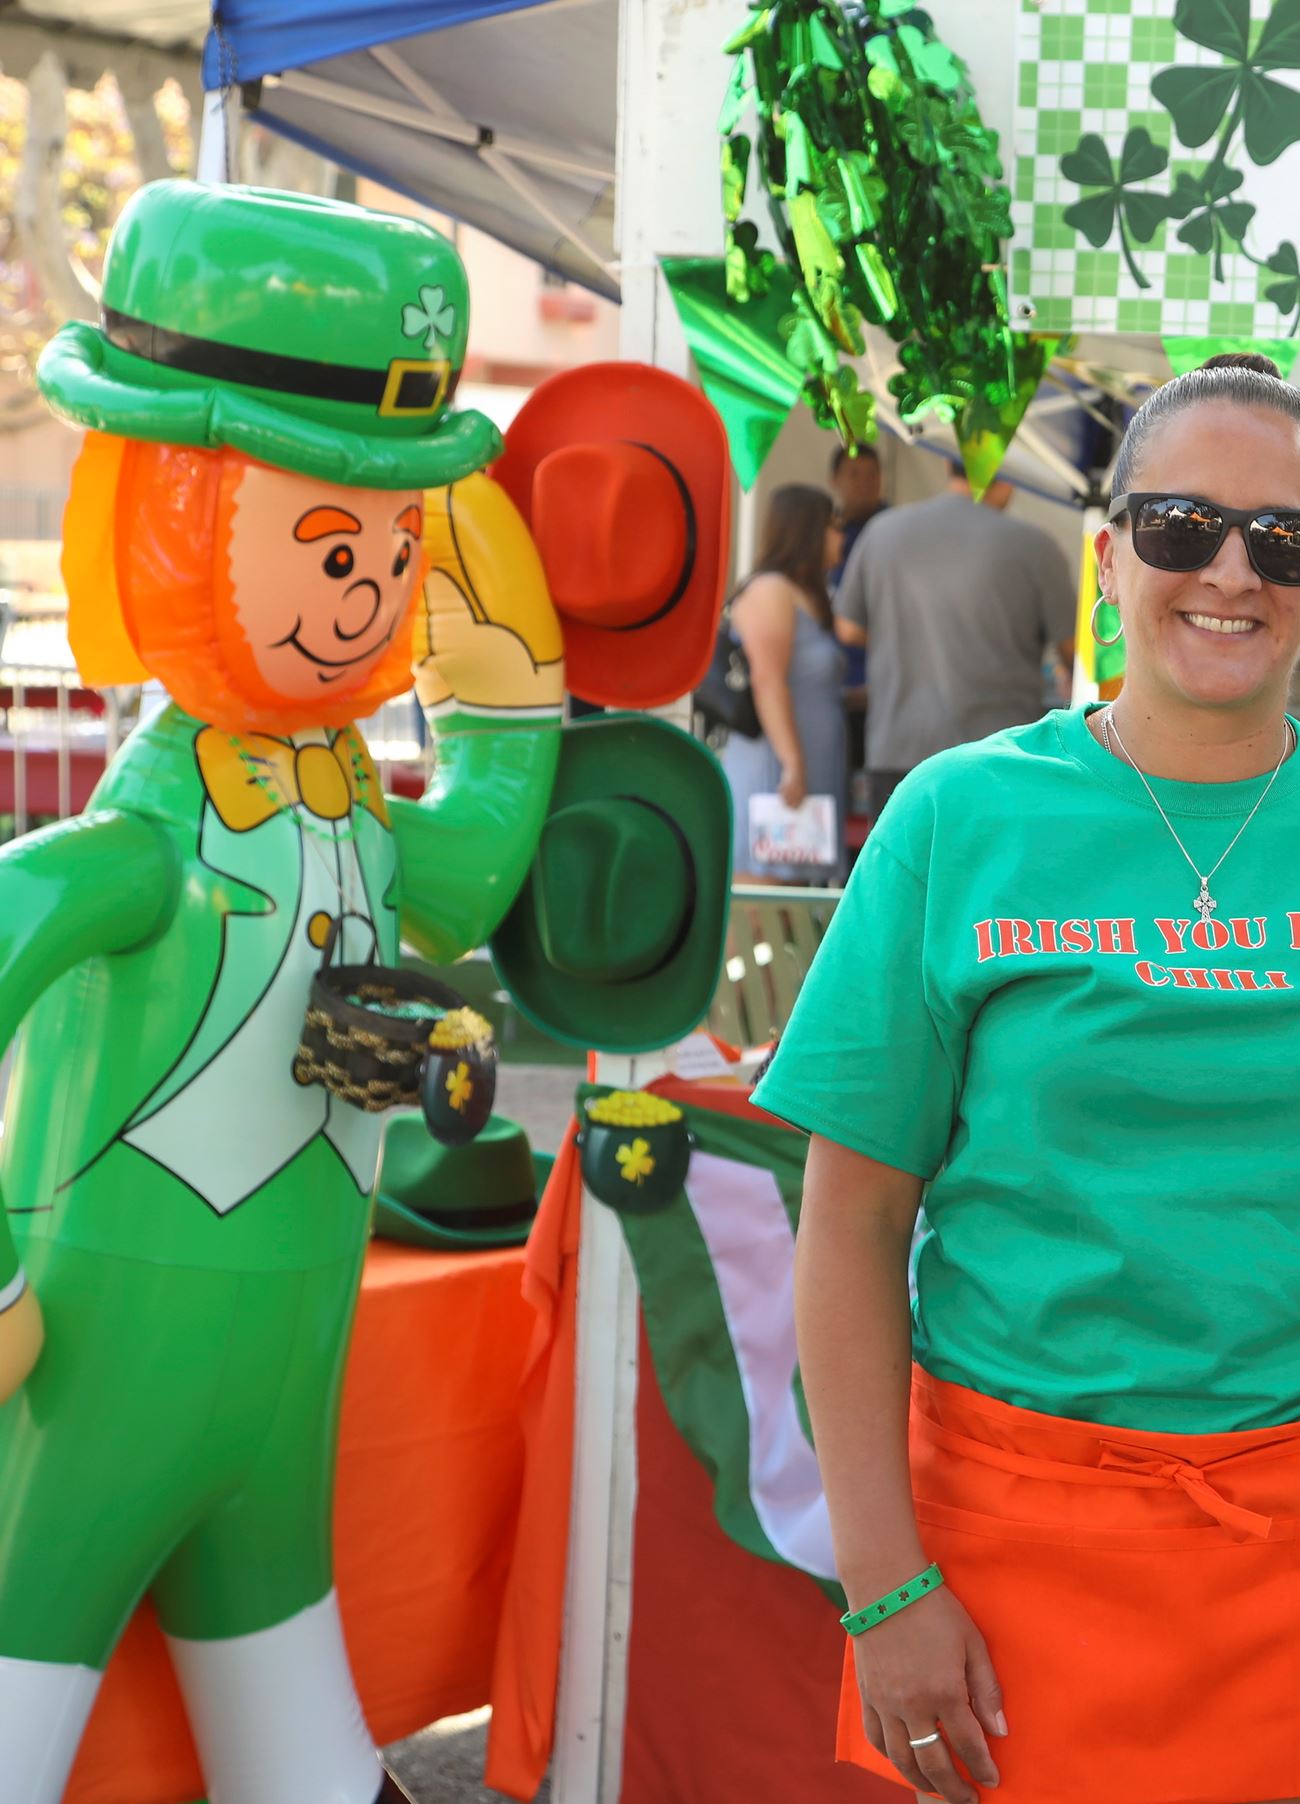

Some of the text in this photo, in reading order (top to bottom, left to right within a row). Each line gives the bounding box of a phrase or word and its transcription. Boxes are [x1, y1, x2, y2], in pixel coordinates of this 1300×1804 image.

[973, 917, 1139, 963] IRISH
[1153, 915, 1268, 955] YOU
[1134, 960, 1294, 991] CHILI
